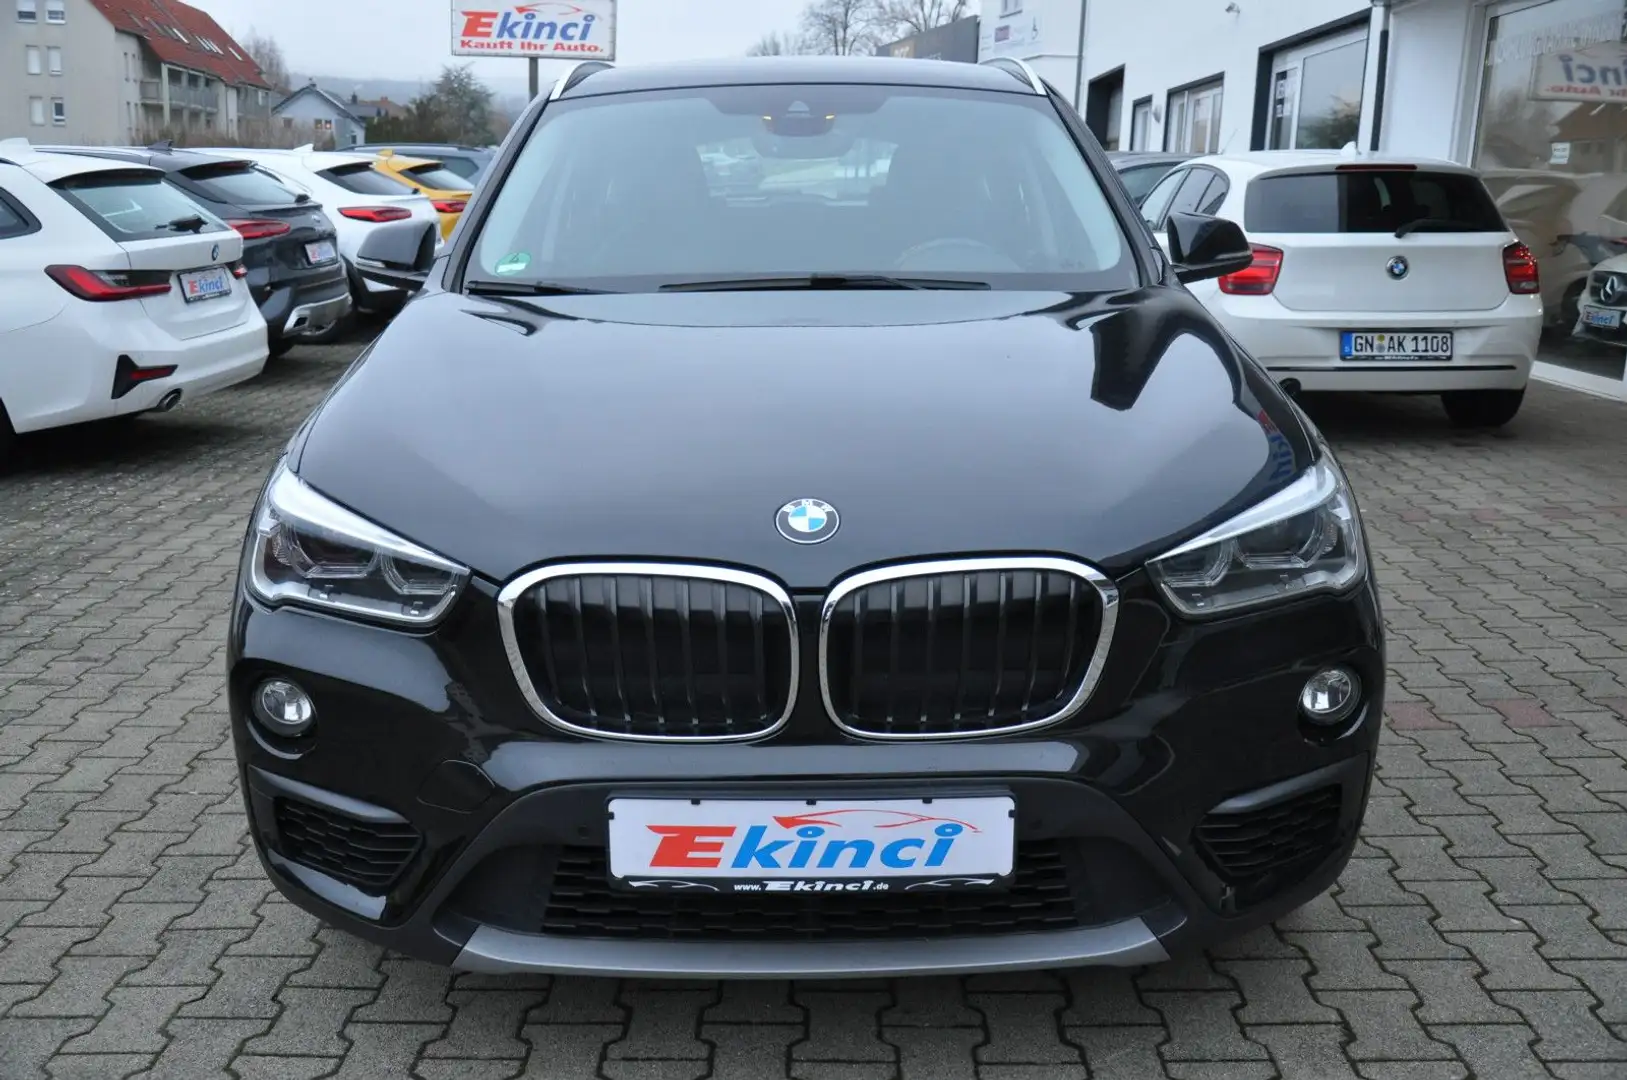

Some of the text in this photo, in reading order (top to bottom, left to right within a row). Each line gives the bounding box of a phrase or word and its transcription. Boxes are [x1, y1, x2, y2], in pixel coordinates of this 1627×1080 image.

[461, 11, 595, 41] Ekinci
[460, 40, 604, 53] Kauft Ihr Auto.
[188, 276, 223, 294] Ekinci
[1354, 335, 1449, 353] GN AK 1108
[645, 823, 964, 868] Ekinci
[733, 880, 889, 891] www.Ekinci.de
